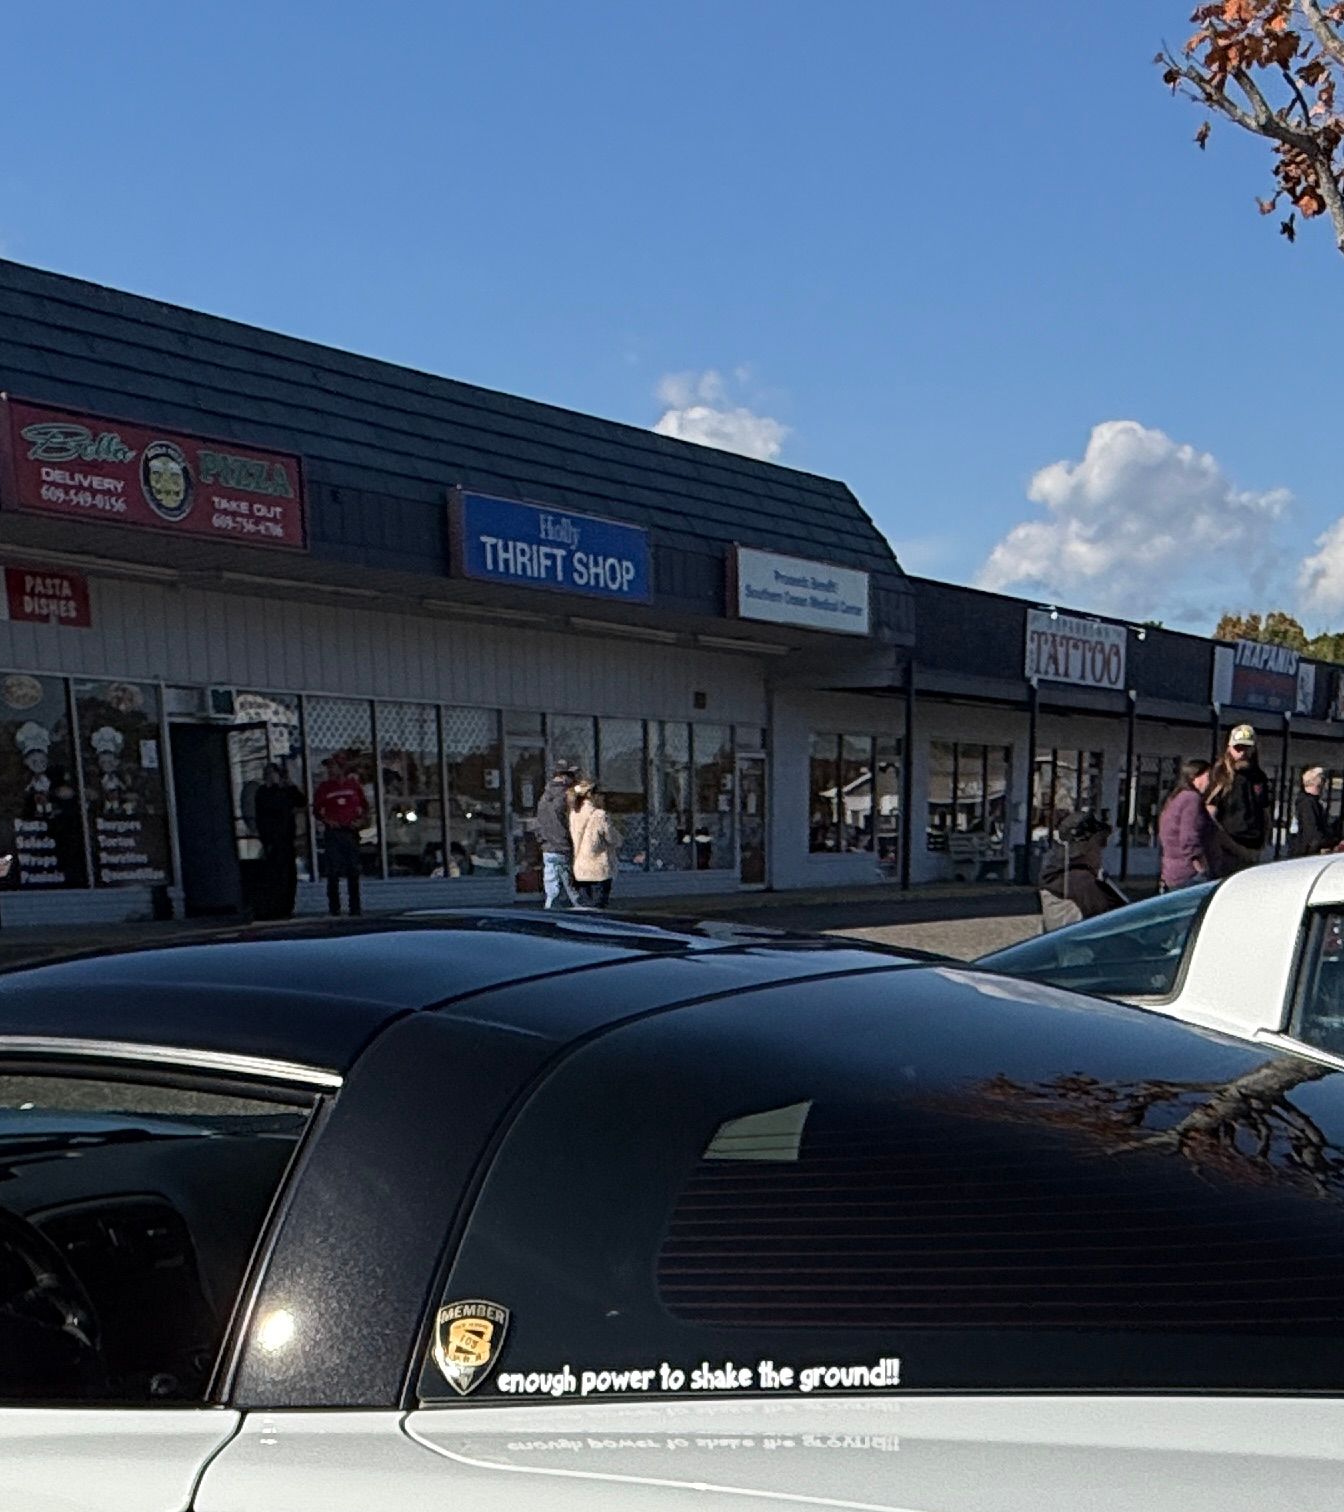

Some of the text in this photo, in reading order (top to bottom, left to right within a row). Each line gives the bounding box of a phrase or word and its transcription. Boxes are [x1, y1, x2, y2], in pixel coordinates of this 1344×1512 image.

[21, 422, 137, 463] Bella
[41, 467, 125, 493] DELIVERY
[197, 449, 294, 498] PIZZA
[212, 497, 283, 519] TAKE OUT
[539, 514, 582, 550] Holly
[480, 535, 635, 592] THRIFT SHOP
[24, 575, 73, 597] PASTA
[24, 596, 78, 619] DISHES
[1031, 630, 1122, 685] TATTOO
[441, 1304, 505, 1324] MEMBER
[498, 1358, 901, 1396] enough power to shake the ground!!
